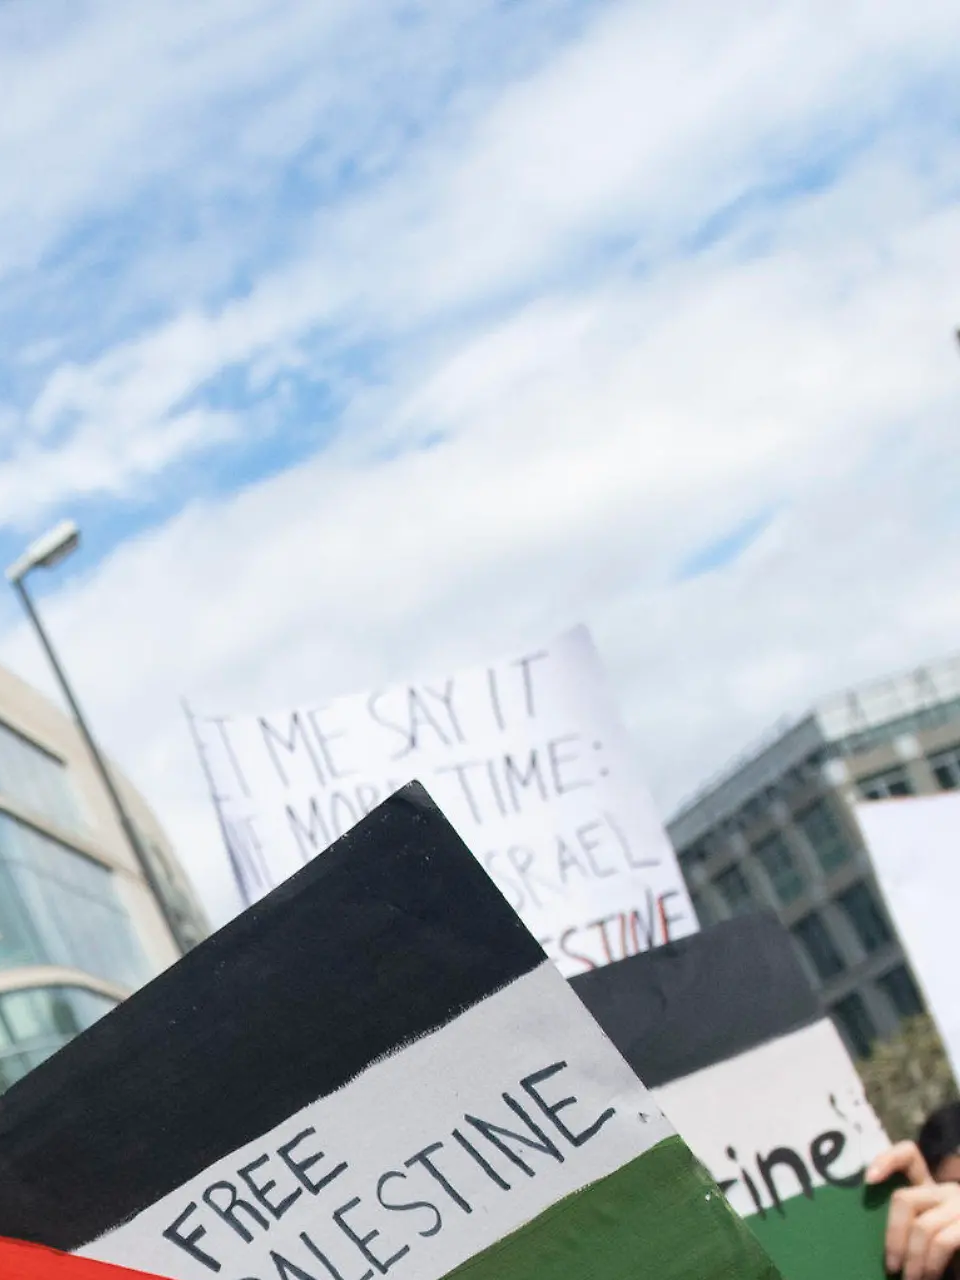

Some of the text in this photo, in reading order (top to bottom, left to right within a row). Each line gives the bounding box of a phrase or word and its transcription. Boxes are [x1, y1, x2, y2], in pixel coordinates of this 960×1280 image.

[257, 705, 360, 790] ME
[366, 678, 465, 762] SAY
[486, 651, 549, 731] IT
[284, 779, 402, 864] MOR
[162, 1126, 349, 1273] FREE
[717, 1129, 866, 1221] ine
